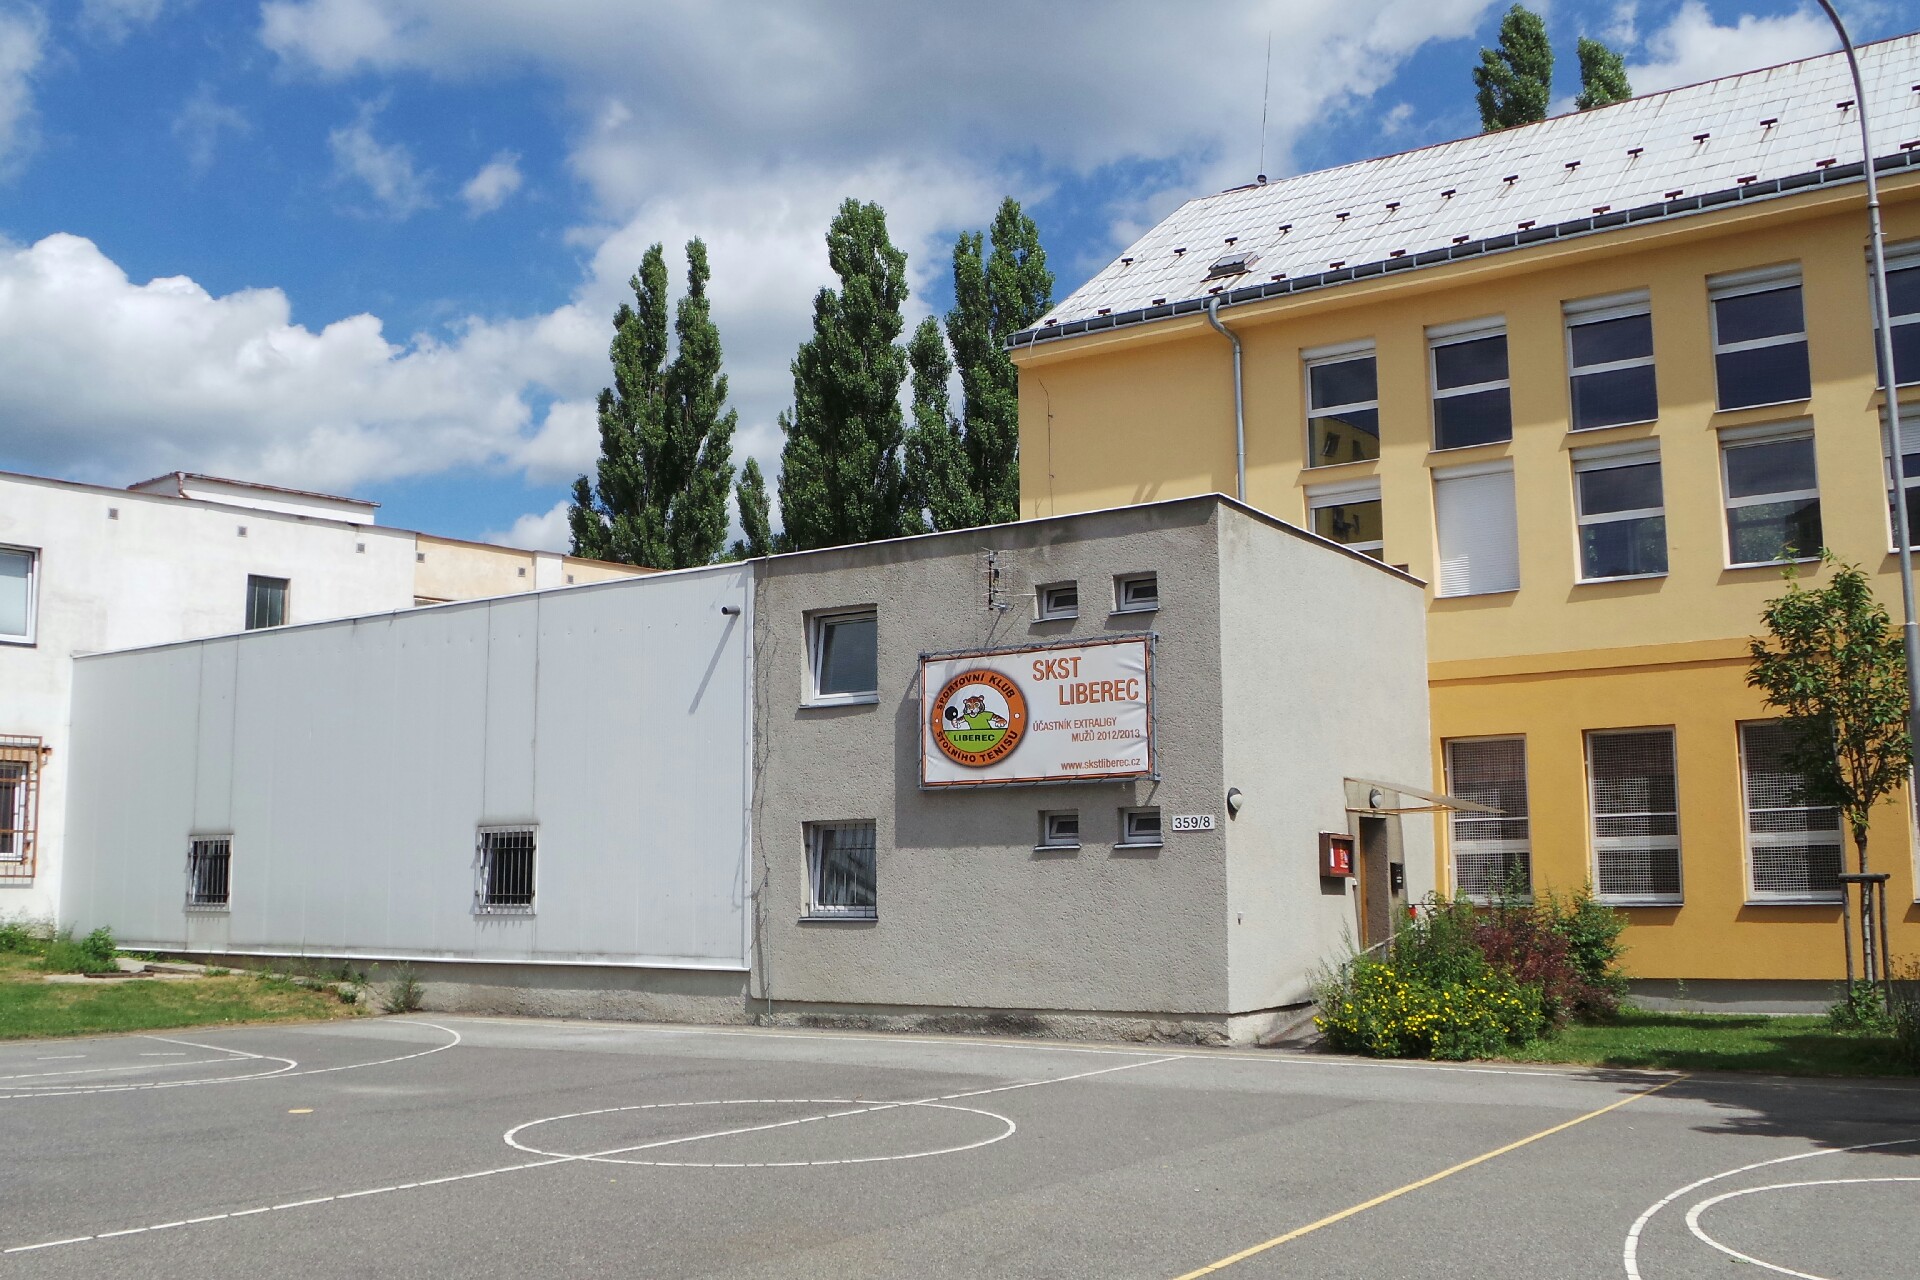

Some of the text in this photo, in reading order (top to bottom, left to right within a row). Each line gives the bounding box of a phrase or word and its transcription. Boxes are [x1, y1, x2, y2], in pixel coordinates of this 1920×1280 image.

[1032, 657, 1081, 681] SKST
[937, 672, 1016, 710] SPORTOVNÍ KLUB
[1059, 678, 1139, 705] LIBEREC
[1033, 717, 1117, 731] ÚČASTNÍK EXTRALIGY
[953, 734, 995, 742] LIBEREC
[1071, 729, 1140, 742] MUŽŮ 2012/2013
[937, 730, 1018, 762] STOLNÍHO TENISU
[1061, 758, 1140, 770] www.skstliberec.cz
[1175, 816, 1210, 828] 359/8
